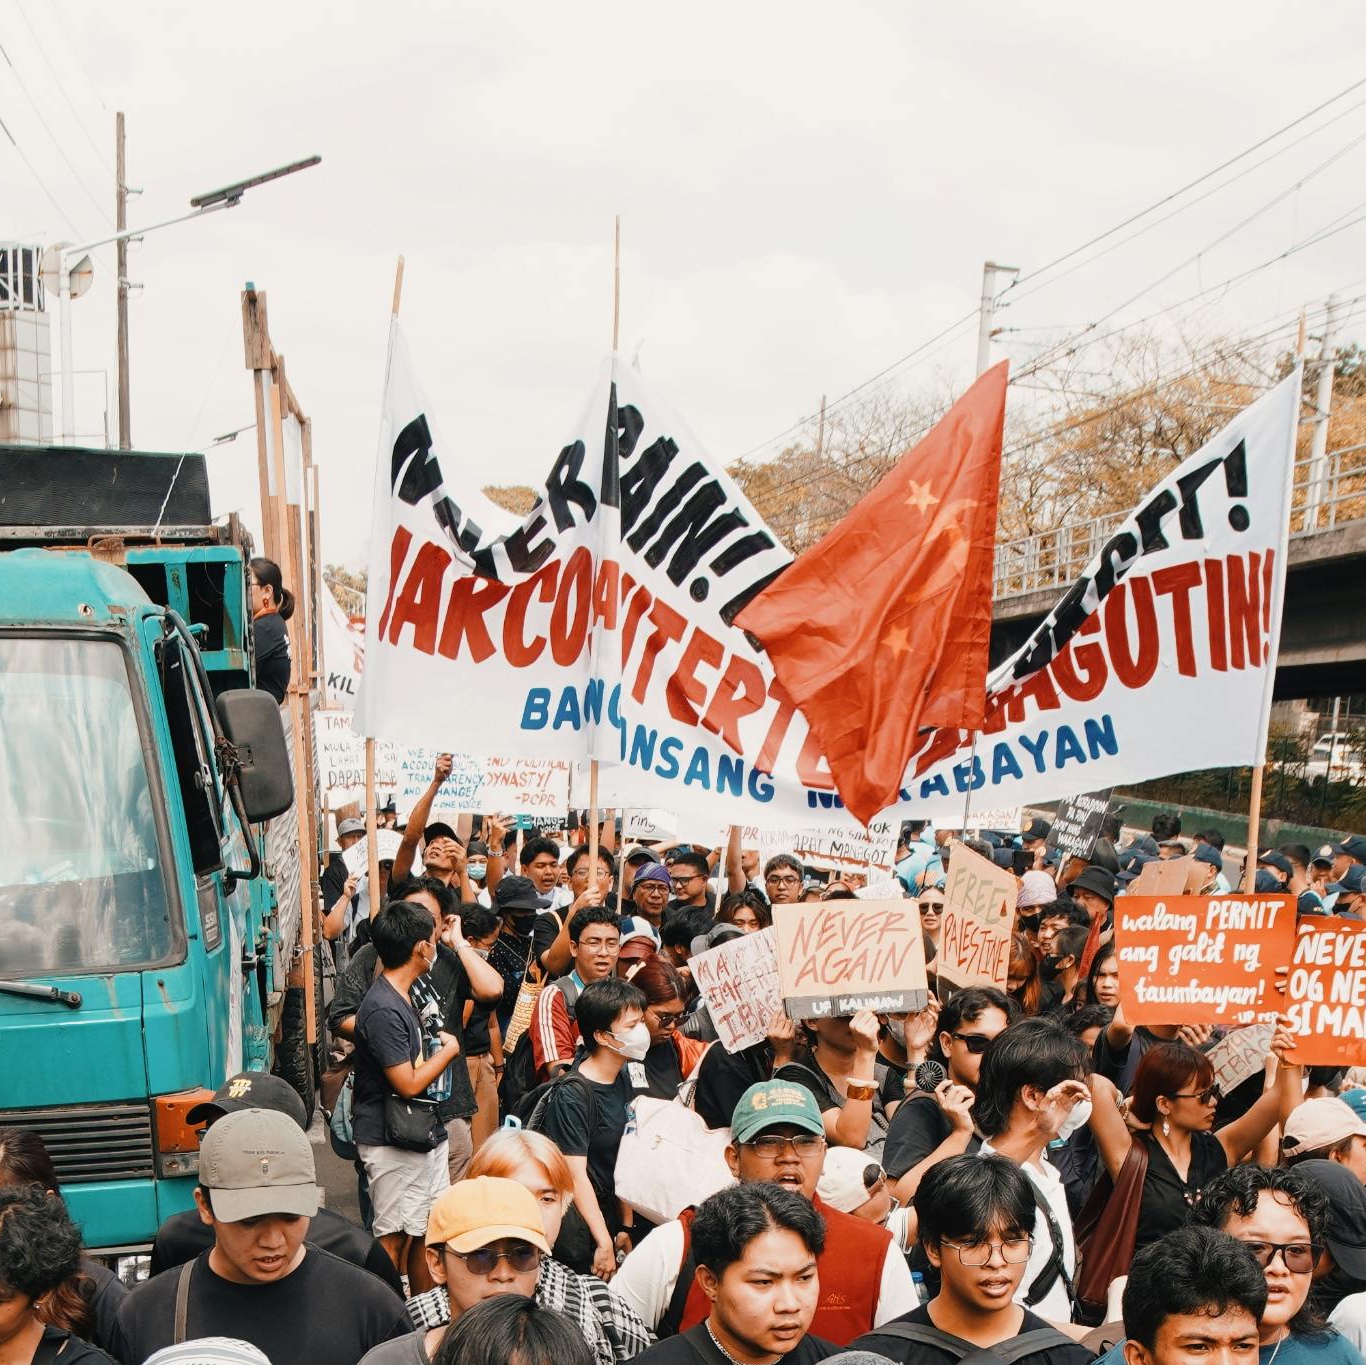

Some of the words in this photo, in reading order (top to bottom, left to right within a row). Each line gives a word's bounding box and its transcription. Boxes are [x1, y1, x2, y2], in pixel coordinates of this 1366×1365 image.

[379, 525, 595, 668] ARCO
[327, 671, 355, 695] KIL
[407, 770, 485, 787] TRANARENCY,
[436, 783, 480, 801] HANGE!
[947, 866, 1009, 926] FREE
[789, 908, 909, 964] NEVER
[1121, 901, 1198, 941] walang
[1205, 899, 1286, 931] PERMIT
[794, 936, 917, 988] AGAIN
[942, 912, 1010, 983] PALESTINE
[1119, 945, 1160, 973] ang
[1168, 930, 1227, 976] galit
[1233, 943, 1263, 973] ng
[1134, 976, 1266, 1015] taumbayan!
[1289, 968, 1324, 1003] OG
[1286, 1001, 1315, 1036] SI
